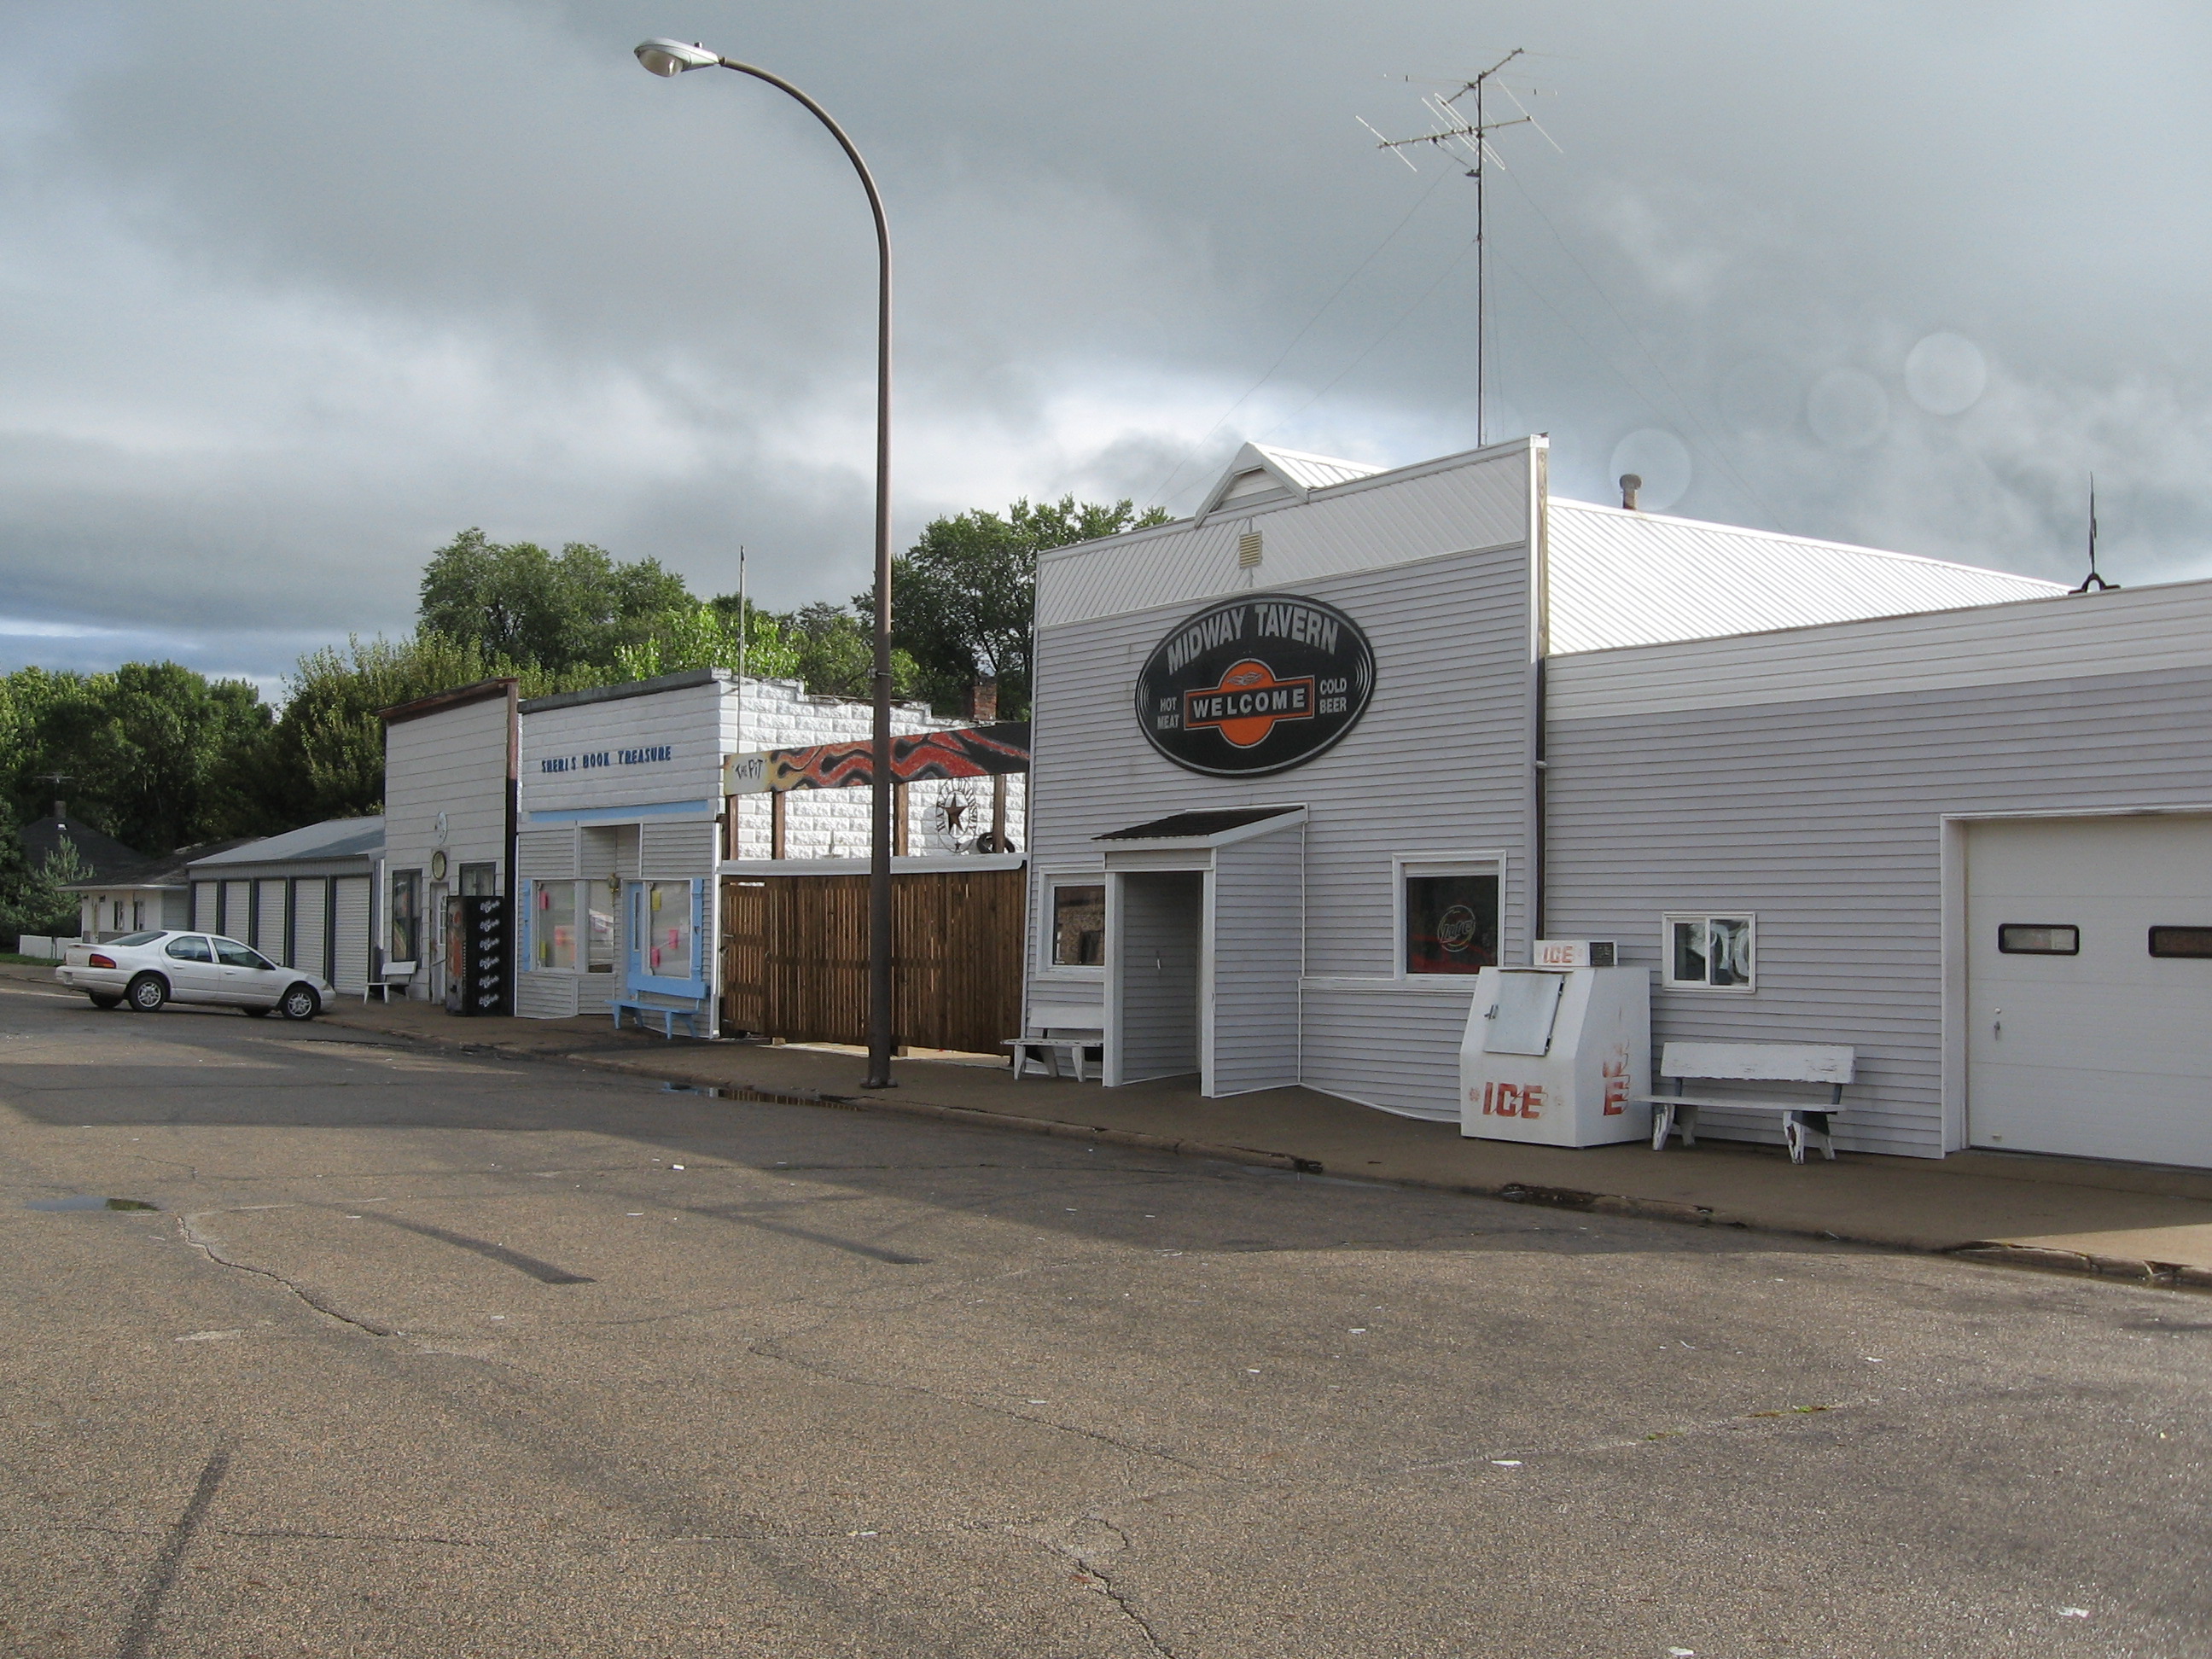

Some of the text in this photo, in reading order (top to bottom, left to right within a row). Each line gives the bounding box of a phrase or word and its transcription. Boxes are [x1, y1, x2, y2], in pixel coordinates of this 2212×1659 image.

[1166, 604, 1339, 676] MIDWAY TAVERN
[1319, 677, 1347, 696] COLD
[1160, 697, 1178, 713] HOT
[1192, 688, 1306, 719] WELCOME
[1319, 696, 1348, 714] BEER
[1157, 713, 1180, 731] MEAT
[582, 752, 610, 769] BOOK
[617, 745, 672, 765] TREASURE
[1543, 946, 1575, 963] ICE
[1482, 1081, 1548, 1119] ICE
